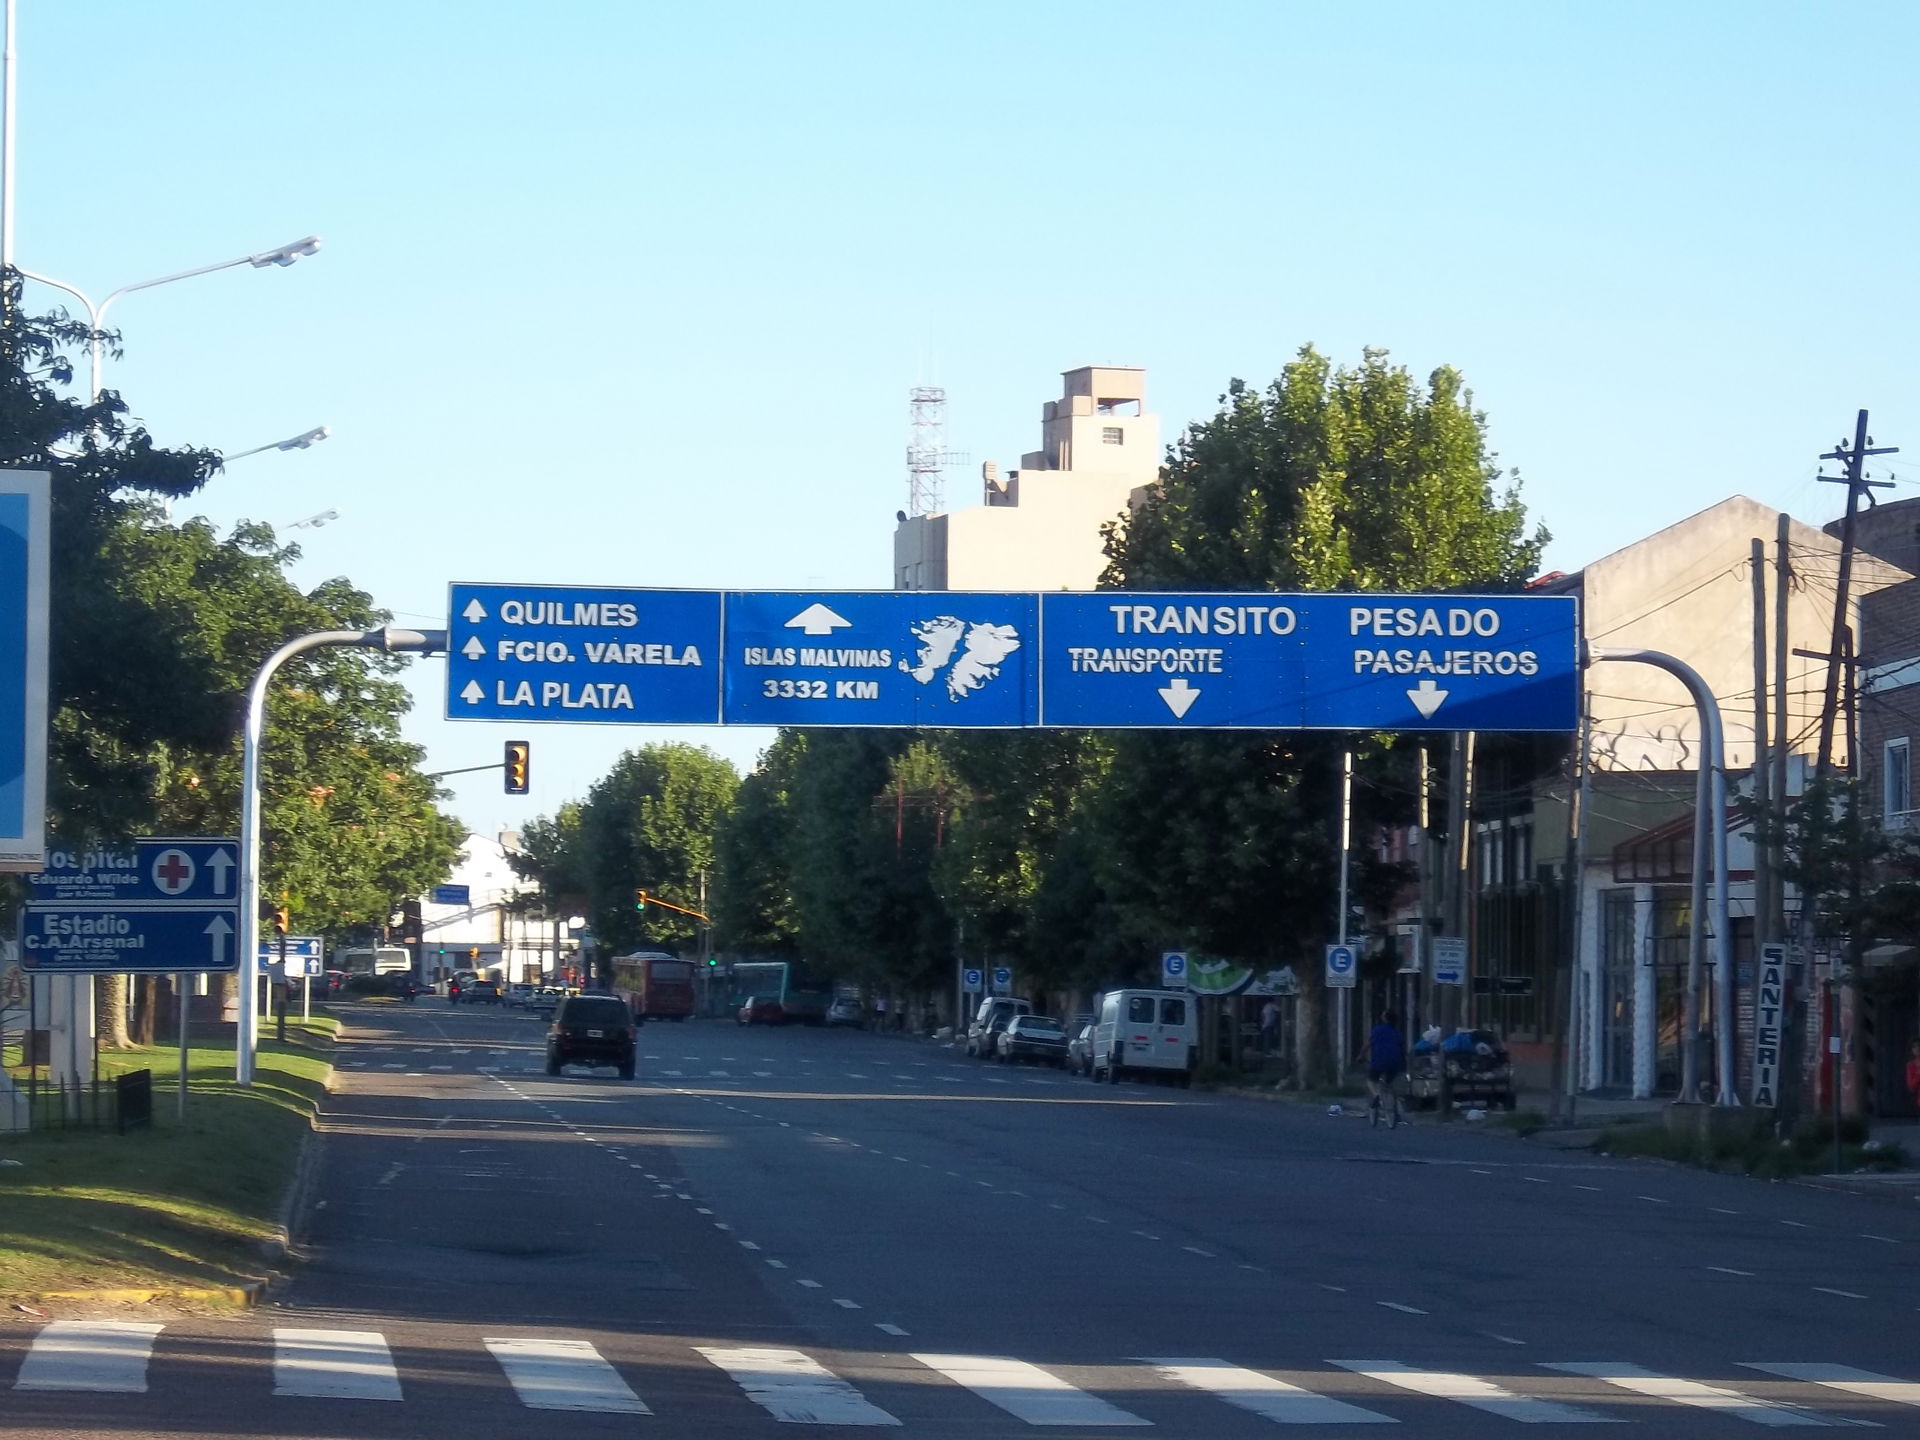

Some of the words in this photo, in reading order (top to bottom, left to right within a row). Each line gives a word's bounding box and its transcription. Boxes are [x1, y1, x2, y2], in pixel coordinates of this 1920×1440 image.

[500, 601, 637, 627] QUILMES
[1110, 605, 1296, 635] TRANSITO
[1350, 608, 1500, 637] PESADO
[497, 640, 575, 664] FCIO.
[585, 643, 702, 667] VARELA
[744, 647, 796, 667] ISLAS
[800, 648, 892, 669] MALVINAS
[1068, 647, 1224, 673] TRANSPORTE
[1354, 650, 1538, 675] PASAJEROS
[496, 680, 536, 707] LA
[542, 682, 634, 710] PLATA
[763, 680, 828, 699] 3332
[836, 680, 879, 700] KM
[29, 874, 94, 884] Eduardo
[97, 874, 140, 884] Wilde
[44, 914, 130, 935] Estadio
[25, 935, 145, 949] C.A.Arsenal
[1171, 959, 1180, 971] E
[1336, 954, 1347, 967] E
[1755, 948, 1783, 1105] SANTERIA
